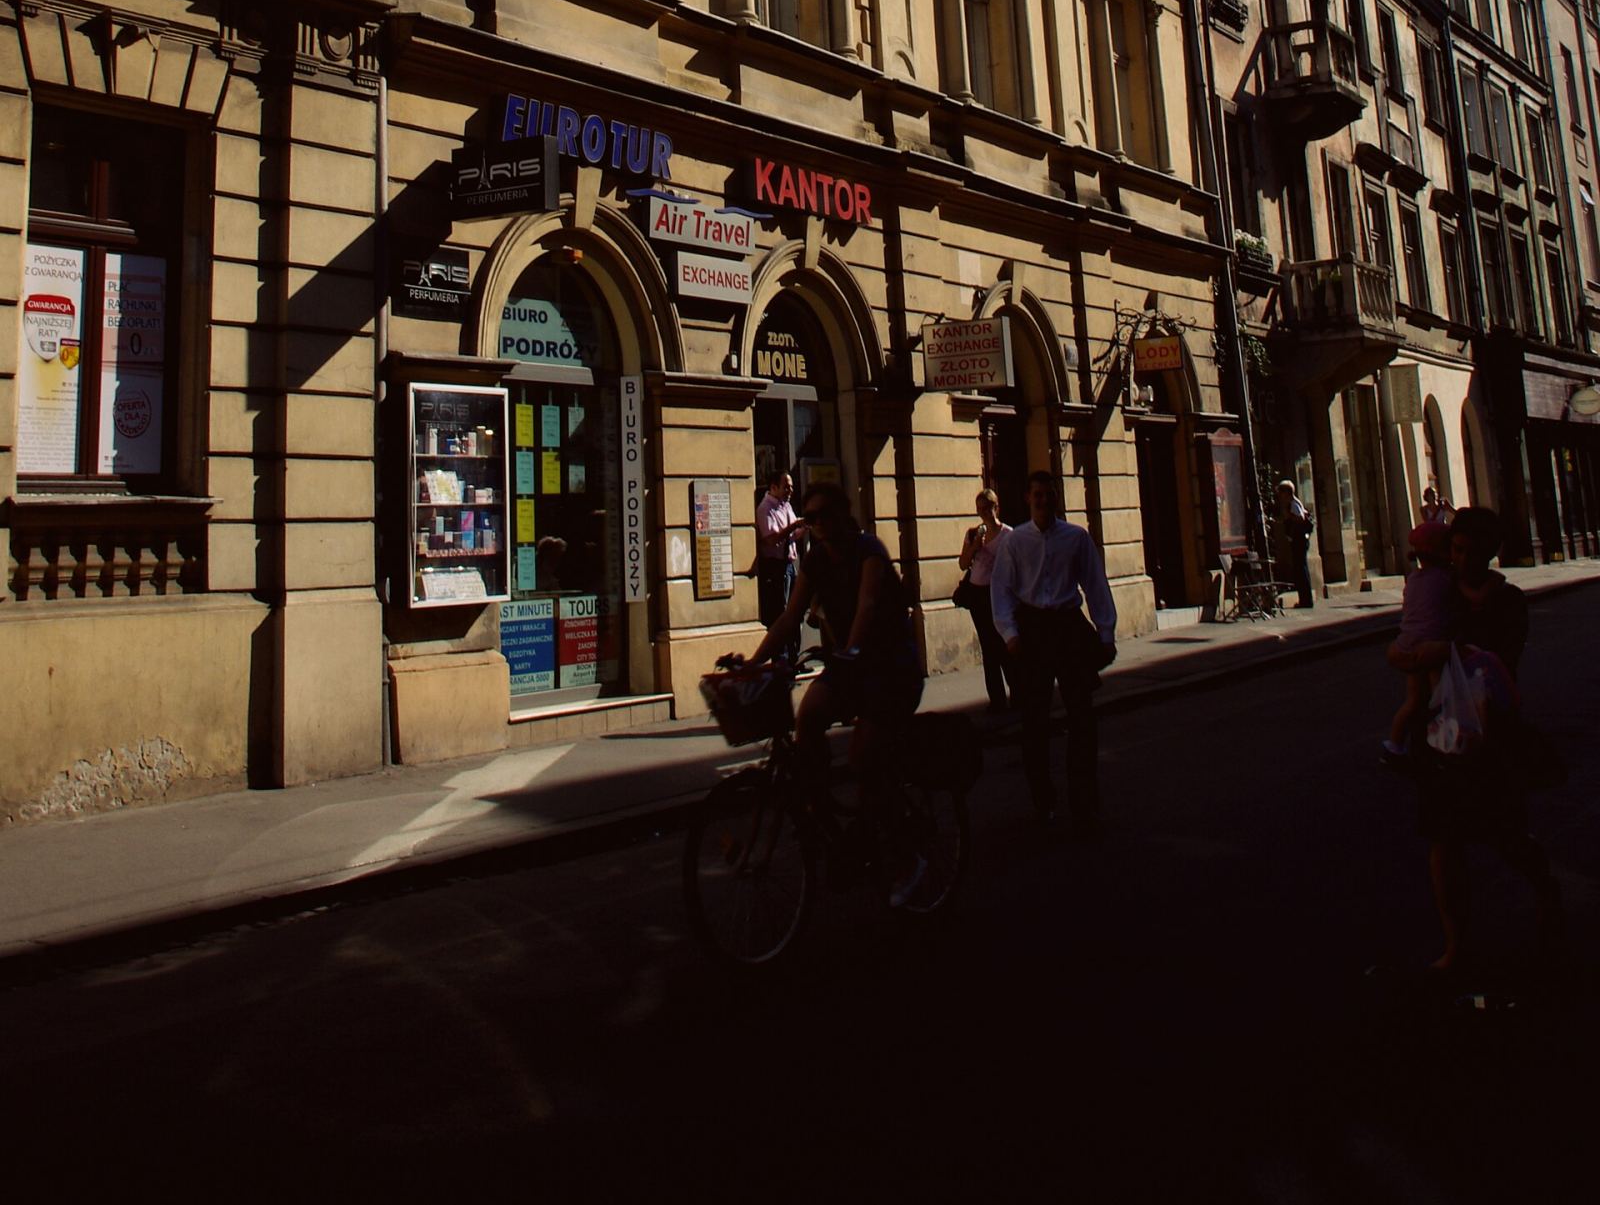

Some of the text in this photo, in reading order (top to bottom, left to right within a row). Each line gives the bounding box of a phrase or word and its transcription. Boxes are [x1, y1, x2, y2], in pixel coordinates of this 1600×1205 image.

[501, 93, 673, 180] EUROTUR
[458, 151, 541, 188] PARIS
[466, 188, 528, 204] PERFUMERIA
[754, 157, 873, 226] KANTOR
[655, 204, 750, 247] Air Travel
[403, 260, 469, 287] PARIS
[682, 265, 749, 291] EXCHANGE
[409, 288, 460, 304] PERFUMERIA
[28, 300, 71, 312] GWARANCJA
[502, 307, 548, 323] BIURO
[38, 328, 59, 338] RATY
[932, 323, 992, 339] KANTOR
[502, 336, 598, 359] PODRÓŻY
[927, 337, 1000, 355] EXCHANGE
[1136, 344, 1179, 360] LODY
[934, 371, 996, 388] MONETY
[625, 381, 641, 597] BIURO PODRÓŻY
[517, 603, 552, 617] MINUTE
[568, 598, 608, 616] TOURS
